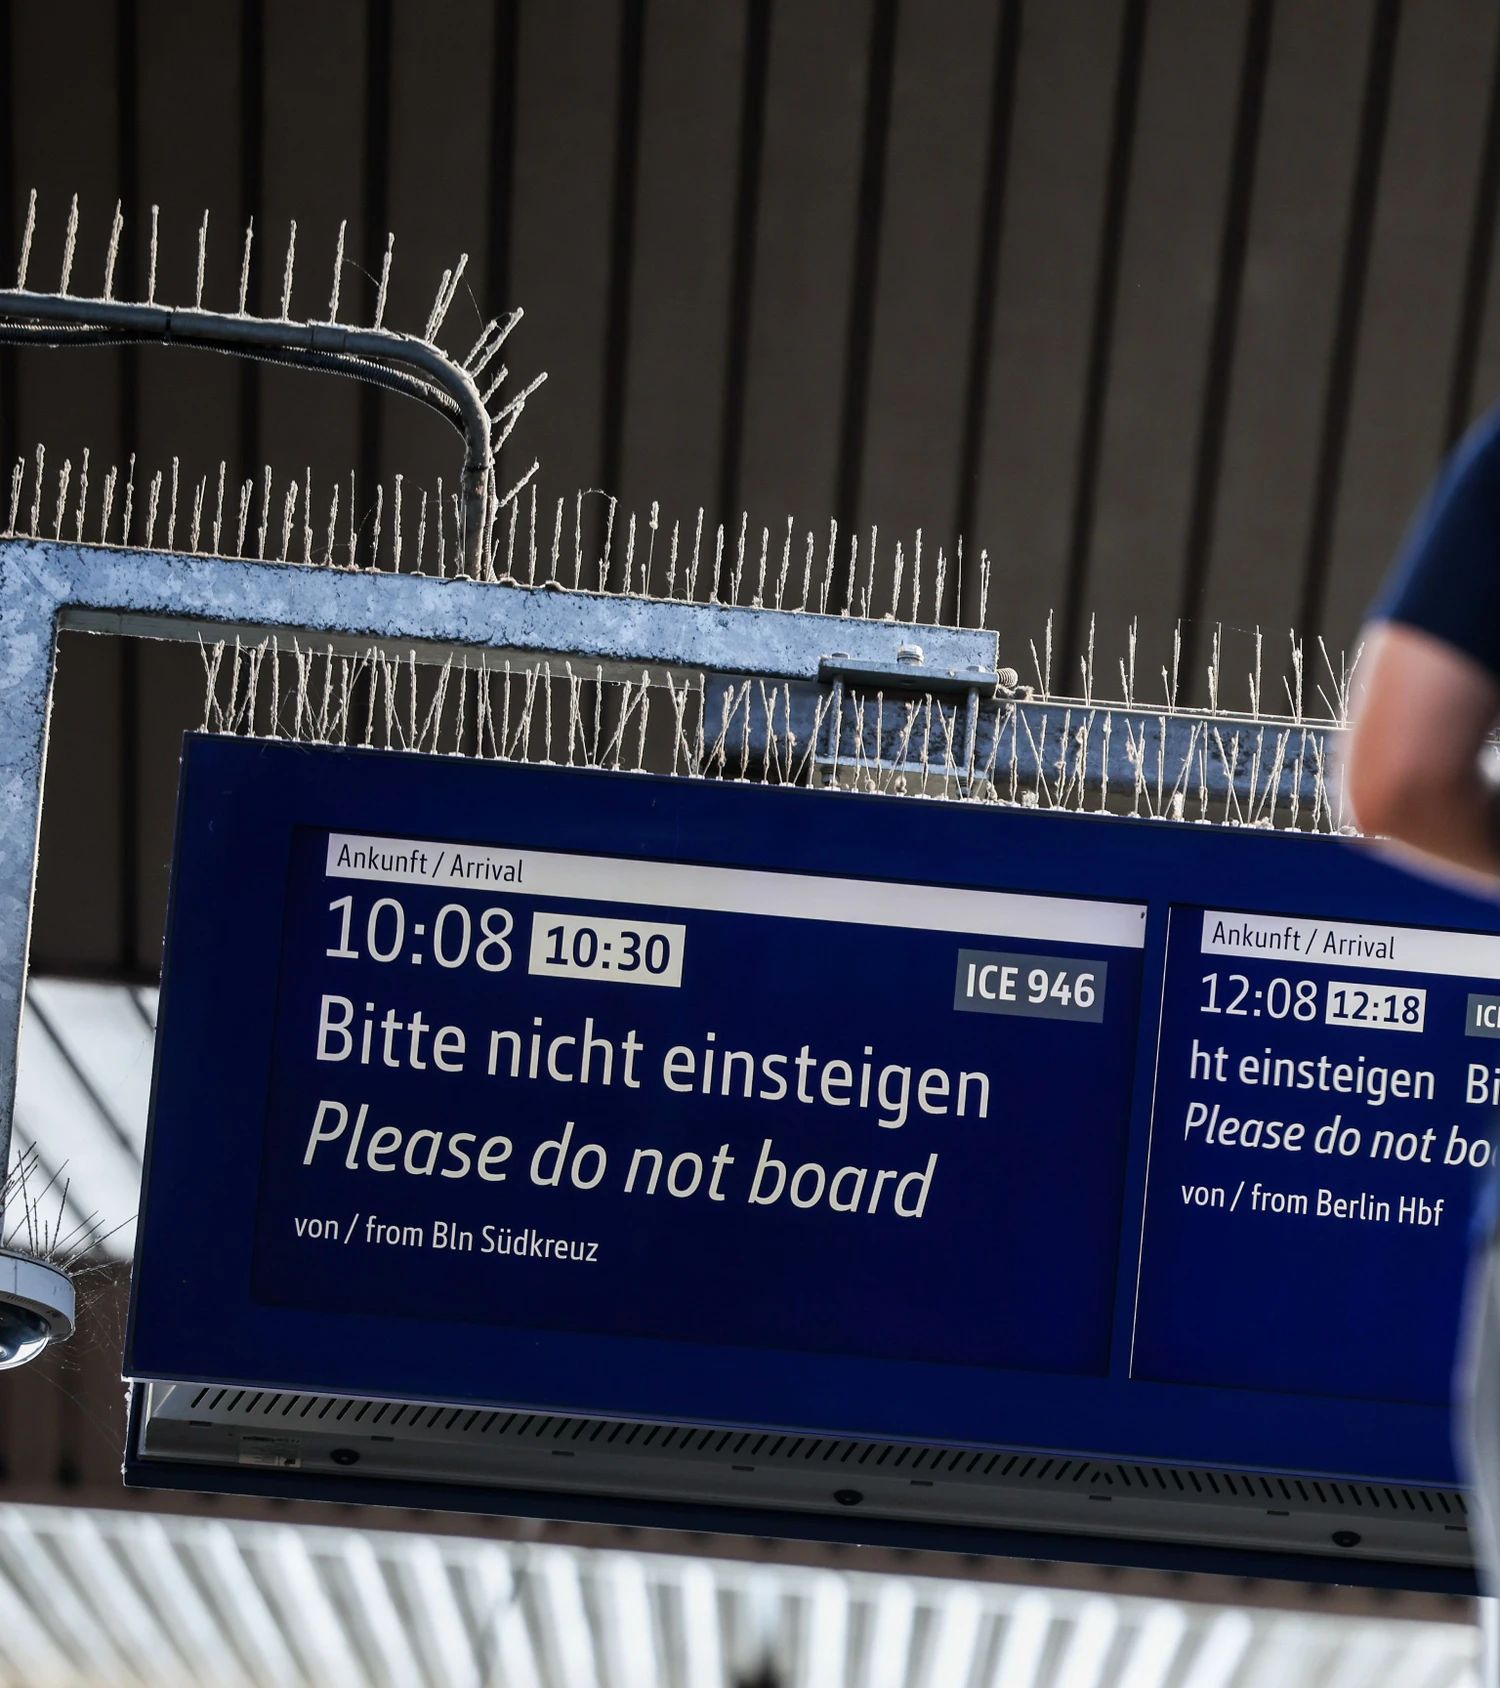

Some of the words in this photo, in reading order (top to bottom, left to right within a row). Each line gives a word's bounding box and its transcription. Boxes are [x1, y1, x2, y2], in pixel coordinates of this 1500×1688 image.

[337, 842, 429, 876] Ankunft
[431, 850, 446, 879] /
[449, 853, 524, 884] Arrival
[326, 895, 515, 972] 10:08
[545, 925, 671, 976] 10:30
[1211, 920, 1302, 953] Ankunft
[1304, 928, 1319, 955] /
[1322, 930, 1396, 960] Arrival
[966, 963, 1019, 1001] ICE
[1027, 968, 1096, 1008] 946
[1200, 972, 1319, 1022] 12:08
[1332, 990, 1421, 1025] 12:18
[316, 994, 467, 1073] Bitte
[487, 1016, 644, 1089] nicht
[663, 1031, 990, 1129] einsteigen
[1190, 1038, 1230, 1082] ht
[1238, 1047, 1436, 1106] einsteigen
[302, 1099, 514, 1182] Please
[529, 1121, 608, 1191] do
[623, 1143, 736, 1202] not
[747, 1138, 939, 1219] board
[1185, 1102, 1307, 1152] Please
[1314, 1114, 1362, 1156] do
[1369, 1127, 1438, 1163] not
[1443, 1124, 1498, 1169] bo
[1181, 1185, 1225, 1208] von
[1229, 1180, 1246, 1212] /
[1251, 1182, 1309, 1215] from
[1316, 1188, 1391, 1222] Berlin
[1398, 1195, 1446, 1227] Hbf
[294, 1217, 340, 1240] von
[344, 1213, 360, 1245] /
[365, 1214, 425, 1248] from
[432, 1219, 474, 1252] Bln
[480, 1225, 600, 1263] Südkreuz
